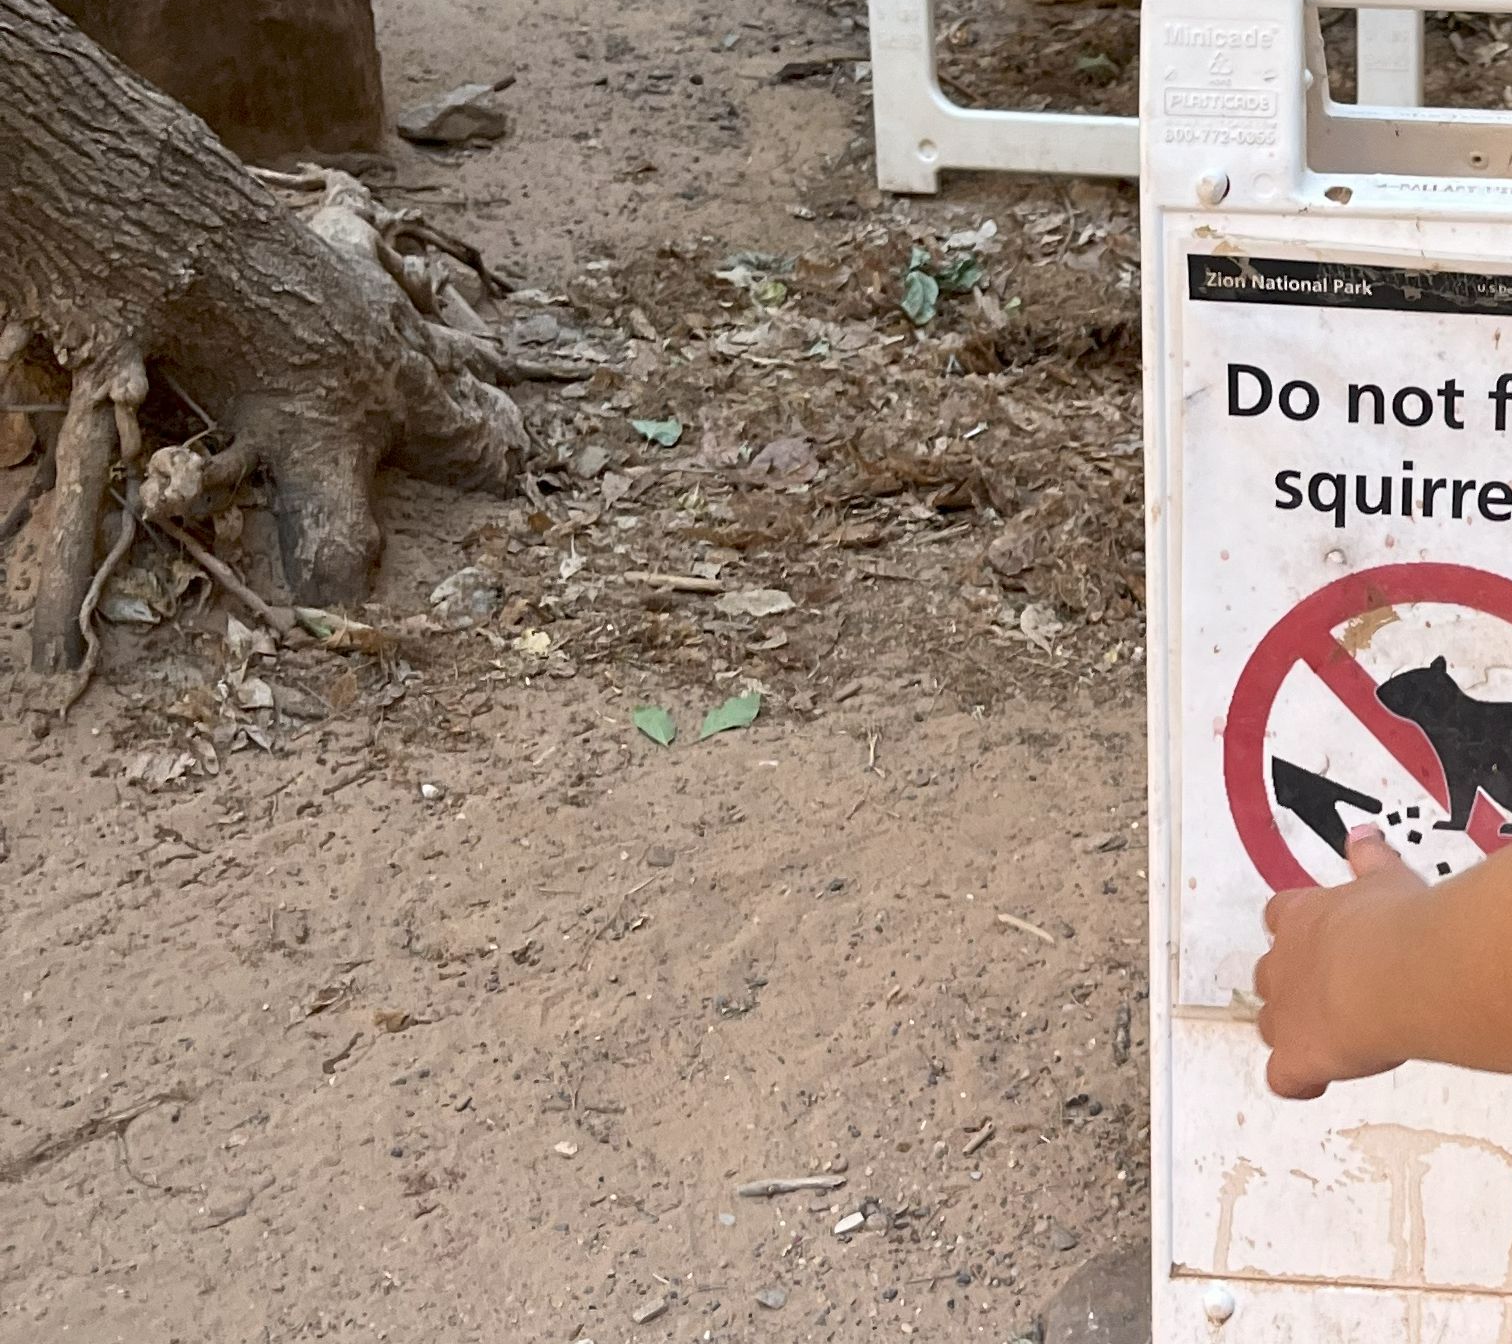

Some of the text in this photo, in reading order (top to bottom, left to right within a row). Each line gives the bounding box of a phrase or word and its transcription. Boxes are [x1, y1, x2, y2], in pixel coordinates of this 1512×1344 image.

[1206, 271, 1372, 296] Zion National Park
[1227, 363, 1320, 421] Do
[1348, 378, 1464, 430] not
